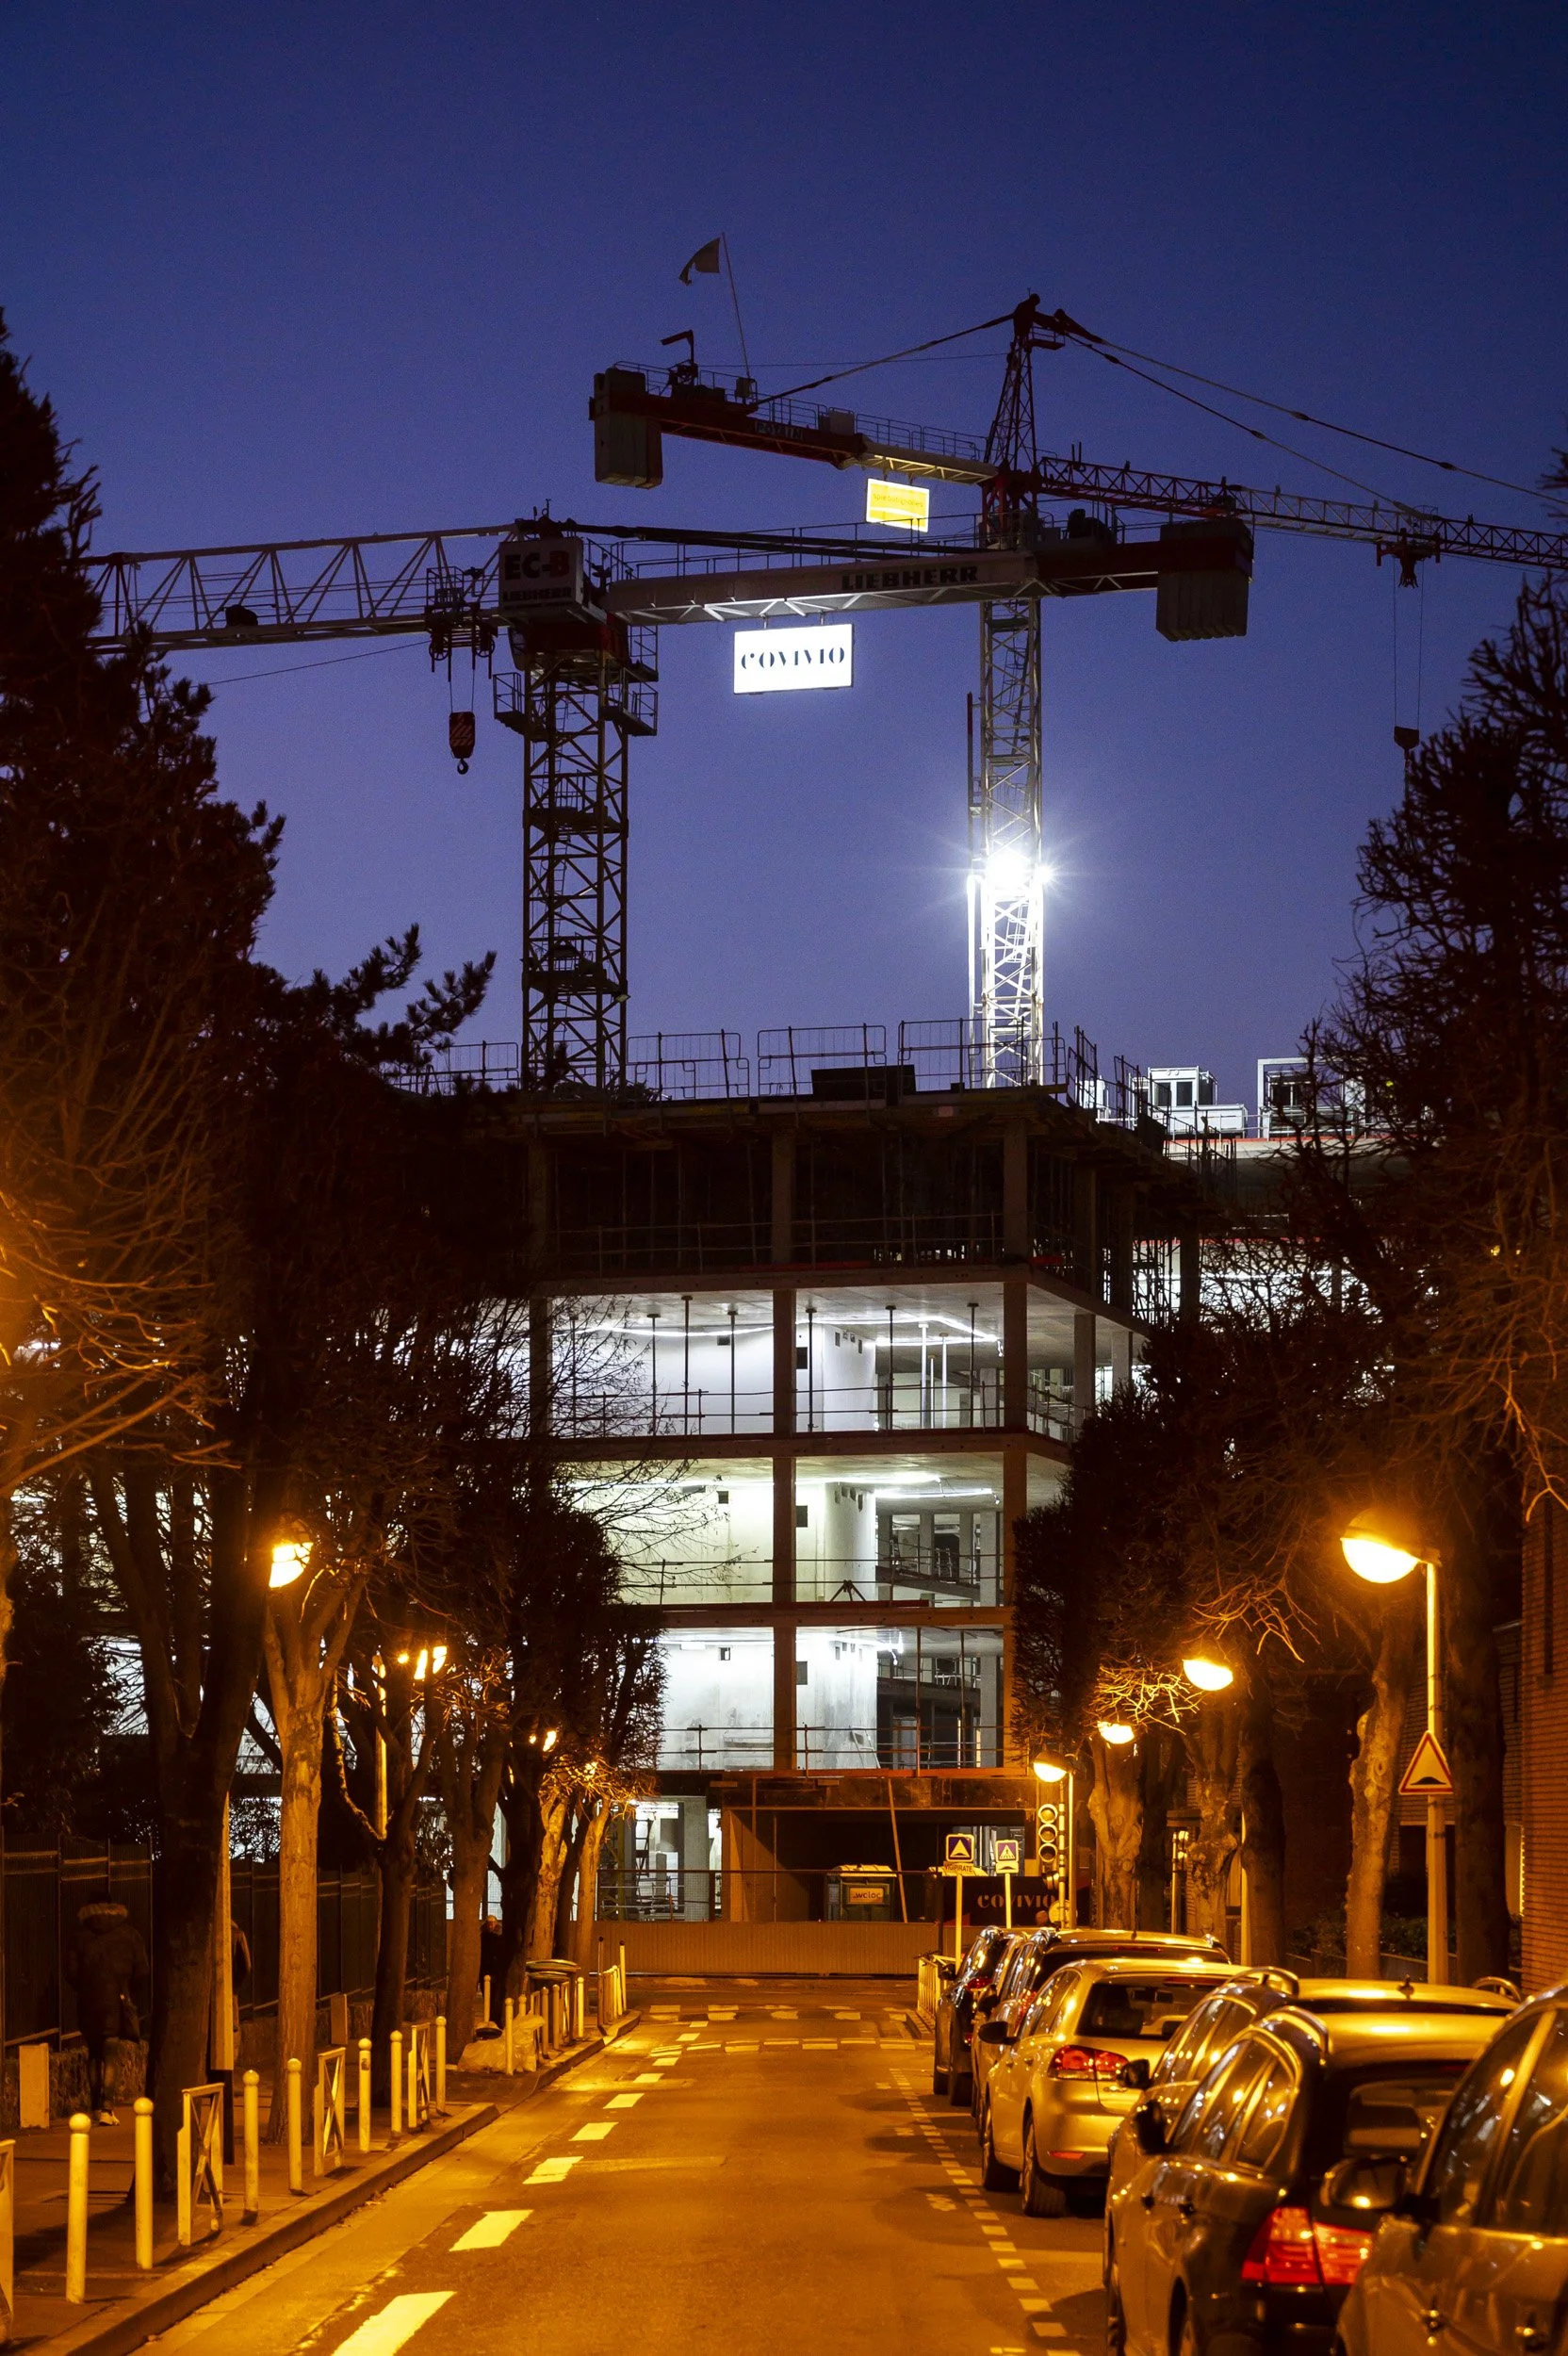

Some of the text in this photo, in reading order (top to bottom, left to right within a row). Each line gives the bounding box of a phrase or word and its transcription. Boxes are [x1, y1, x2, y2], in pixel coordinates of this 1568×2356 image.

[504, 550, 570, 580] EC-B
[841, 566, 978, 591] LIEBHERR
[741, 646, 845, 670] COVIVIO
